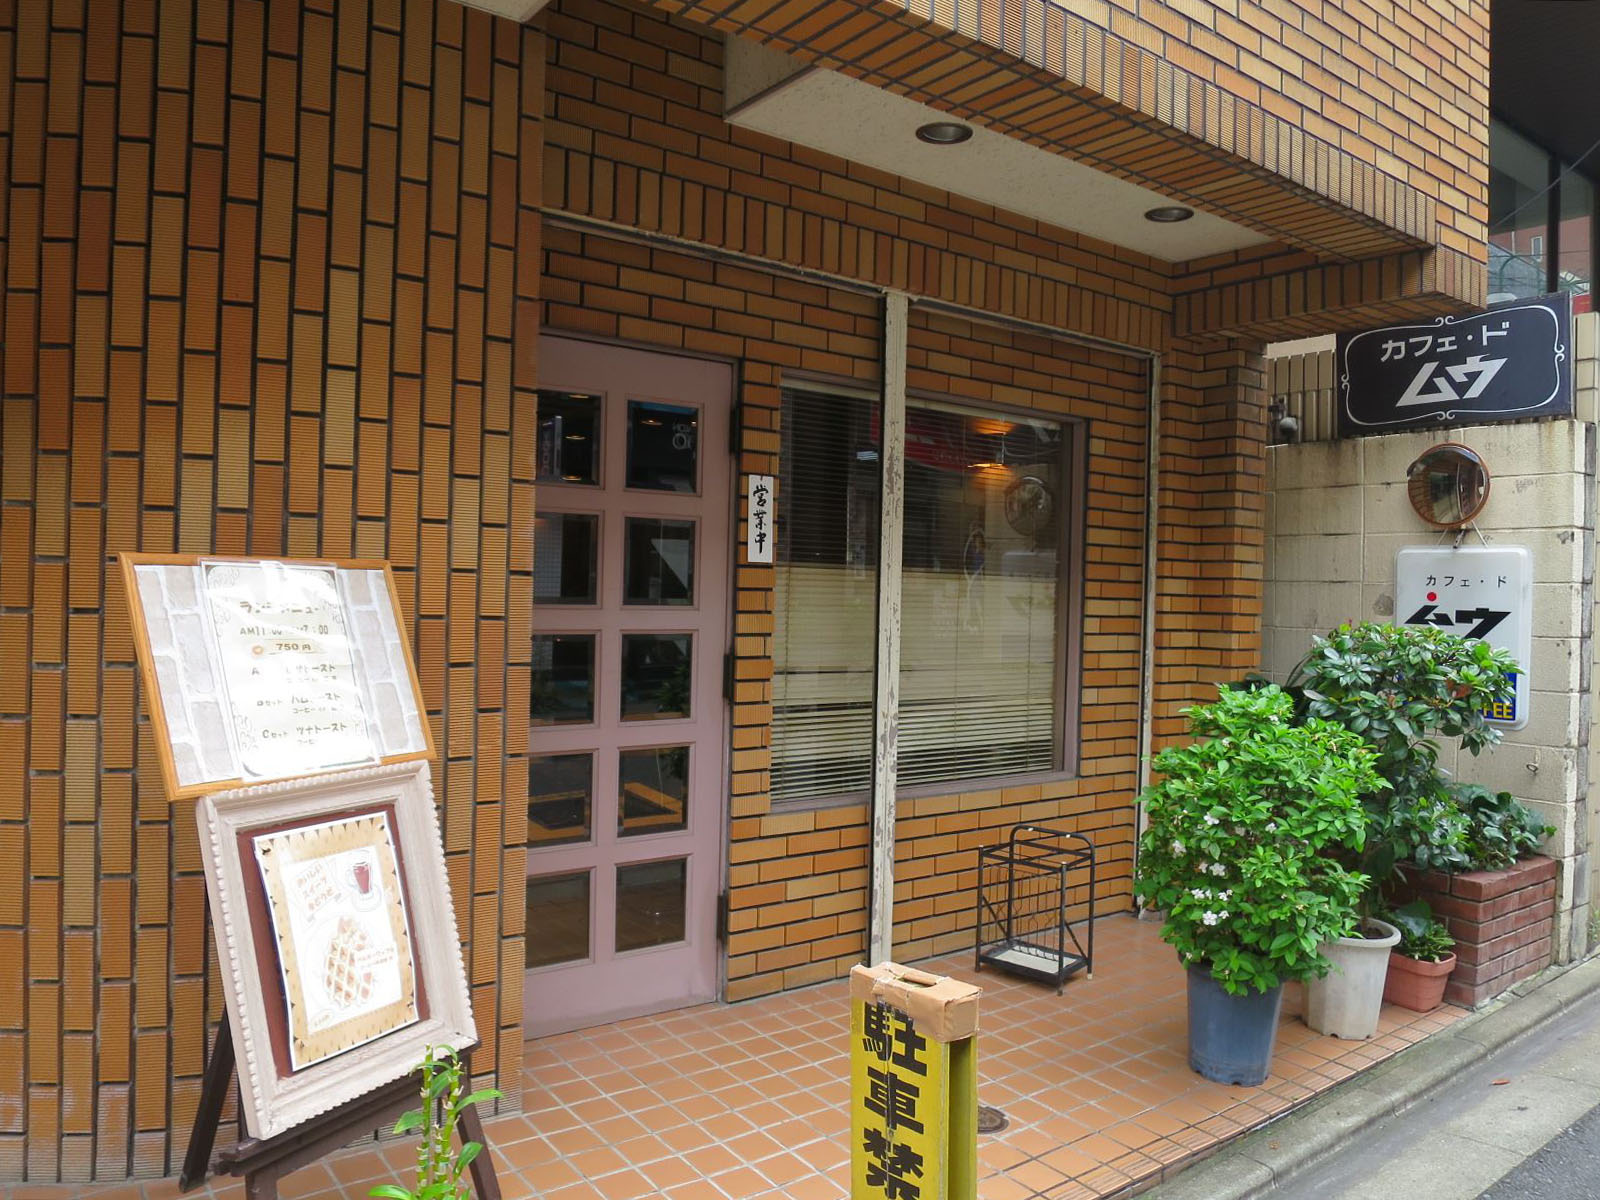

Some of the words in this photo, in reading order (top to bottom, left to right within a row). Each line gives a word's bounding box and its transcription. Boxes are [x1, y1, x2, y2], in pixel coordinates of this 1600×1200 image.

[1380, 321, 1509, 362] カフェ・ド
[1395, 353, 1508, 407] ムウ
[752, 483, 769, 554] 営業中
[1425, 575, 1508, 588] カフェ・ド
[275, 643, 312, 652] 750円
